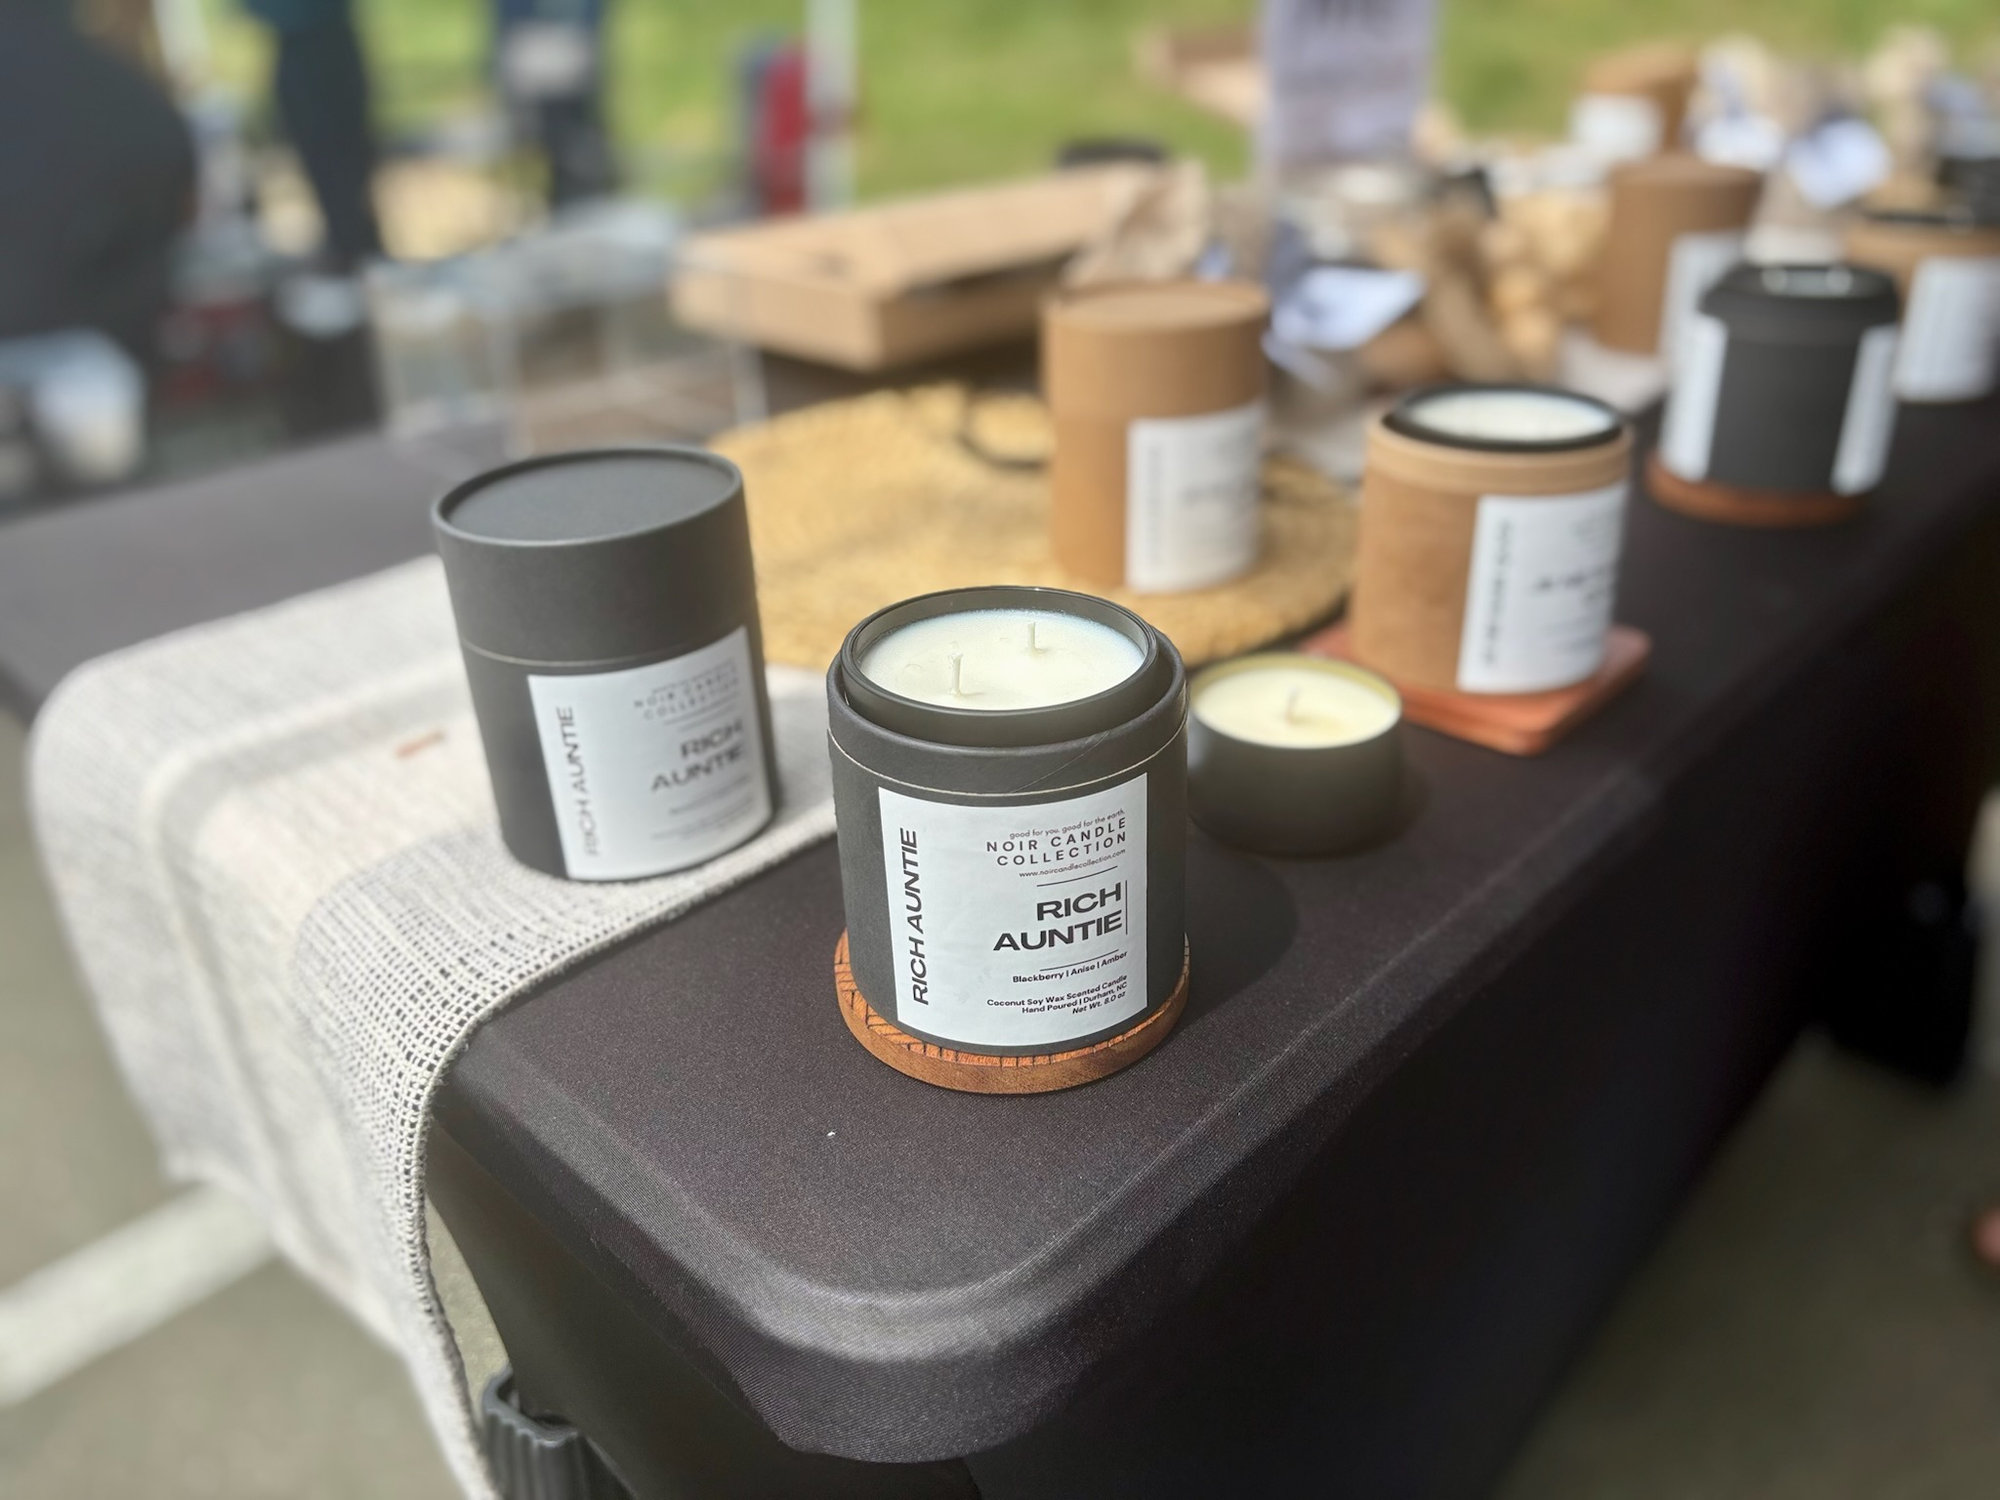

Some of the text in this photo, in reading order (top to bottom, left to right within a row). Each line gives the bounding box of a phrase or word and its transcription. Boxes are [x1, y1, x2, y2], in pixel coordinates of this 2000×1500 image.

[680, 718, 743, 758] RICH
[556, 707, 600, 857] RICH AUNTIE
[651, 744, 743, 791] AUNTIE
[986, 817, 1126, 852] NOIR CANDLE
[1009, 829, 1030, 840] good
[1032, 828, 1043, 836] for
[1062, 821, 1081, 834] good
[1083, 820, 1093, 828] for
[1095, 816, 1105, 825] the
[997, 831, 1126, 866] COLLECTION
[1019, 849, 1126, 878] www.noircandlecollection.com
[900, 827, 929, 1006] RICH AUNTIE
[1036, 882, 1121, 921] RICH
[993, 909, 1122, 951] AUNTIE
[1012, 971, 1064, 984] Blackberry
[1071, 965, 1096, 976] Anise
[1101, 951, 1128, 968] Amber
[986, 974, 1127, 1007] Coconut Soy Wax Scented Candle
[1022, 1005, 1045, 1014] Hand
[1047, 1000, 1078, 1011] Poured
[1116, 981, 1127, 992] NC
[1072, 1005, 1087, 1015] Net
[1104, 994, 1117, 1005] 8.0
[1117, 990, 1126, 999] oz
